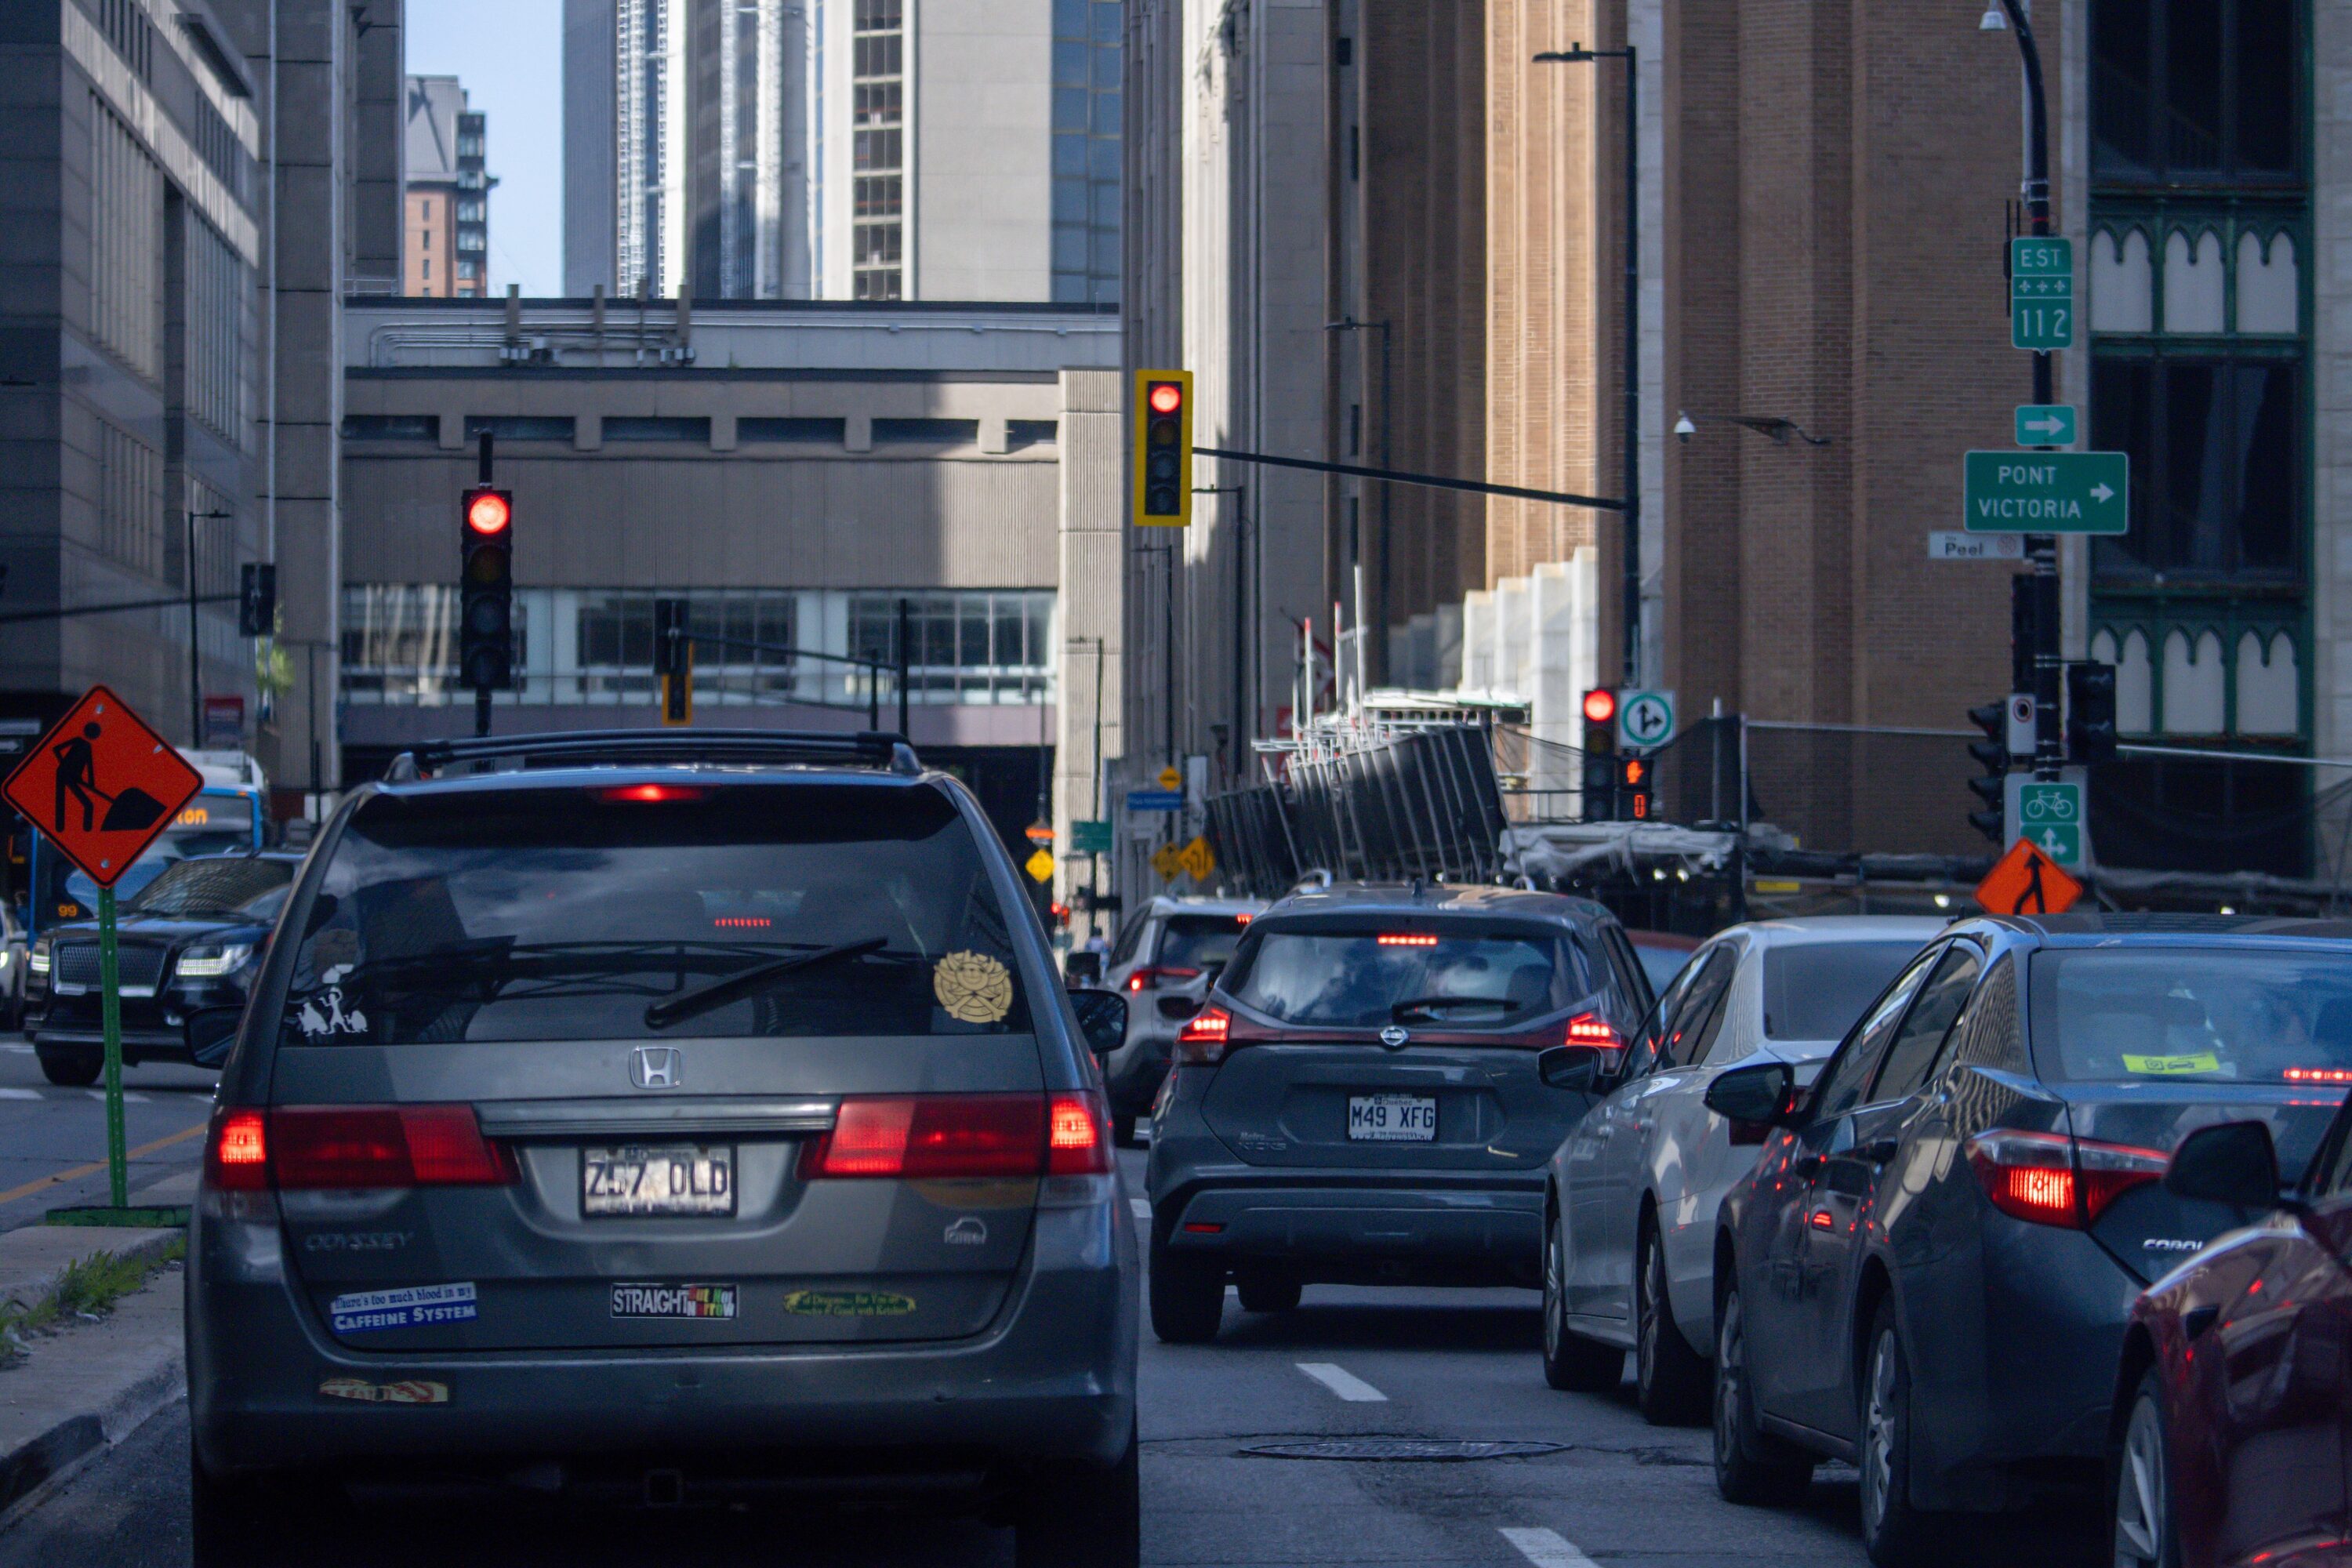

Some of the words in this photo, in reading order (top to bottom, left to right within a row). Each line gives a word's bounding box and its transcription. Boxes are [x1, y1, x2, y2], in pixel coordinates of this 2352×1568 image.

[2020, 249, 2062, 267] EST
[2021, 308, 2067, 338] 112
[1998, 466, 2056, 485] PONT
[1978, 498, 2082, 519] VICTORIA
[1944, 542, 1984, 556] Peel
[1351, 1105, 1387, 1127] M49
[1399, 1106, 1434, 1128] XFG
[372, 1294, 386, 1305] too
[388, 1290, 414, 1304] much
[416, 1287, 442, 1301] blood
[444, 1288, 454, 1298] in
[613, 1289, 688, 1313] STRAIGHT
